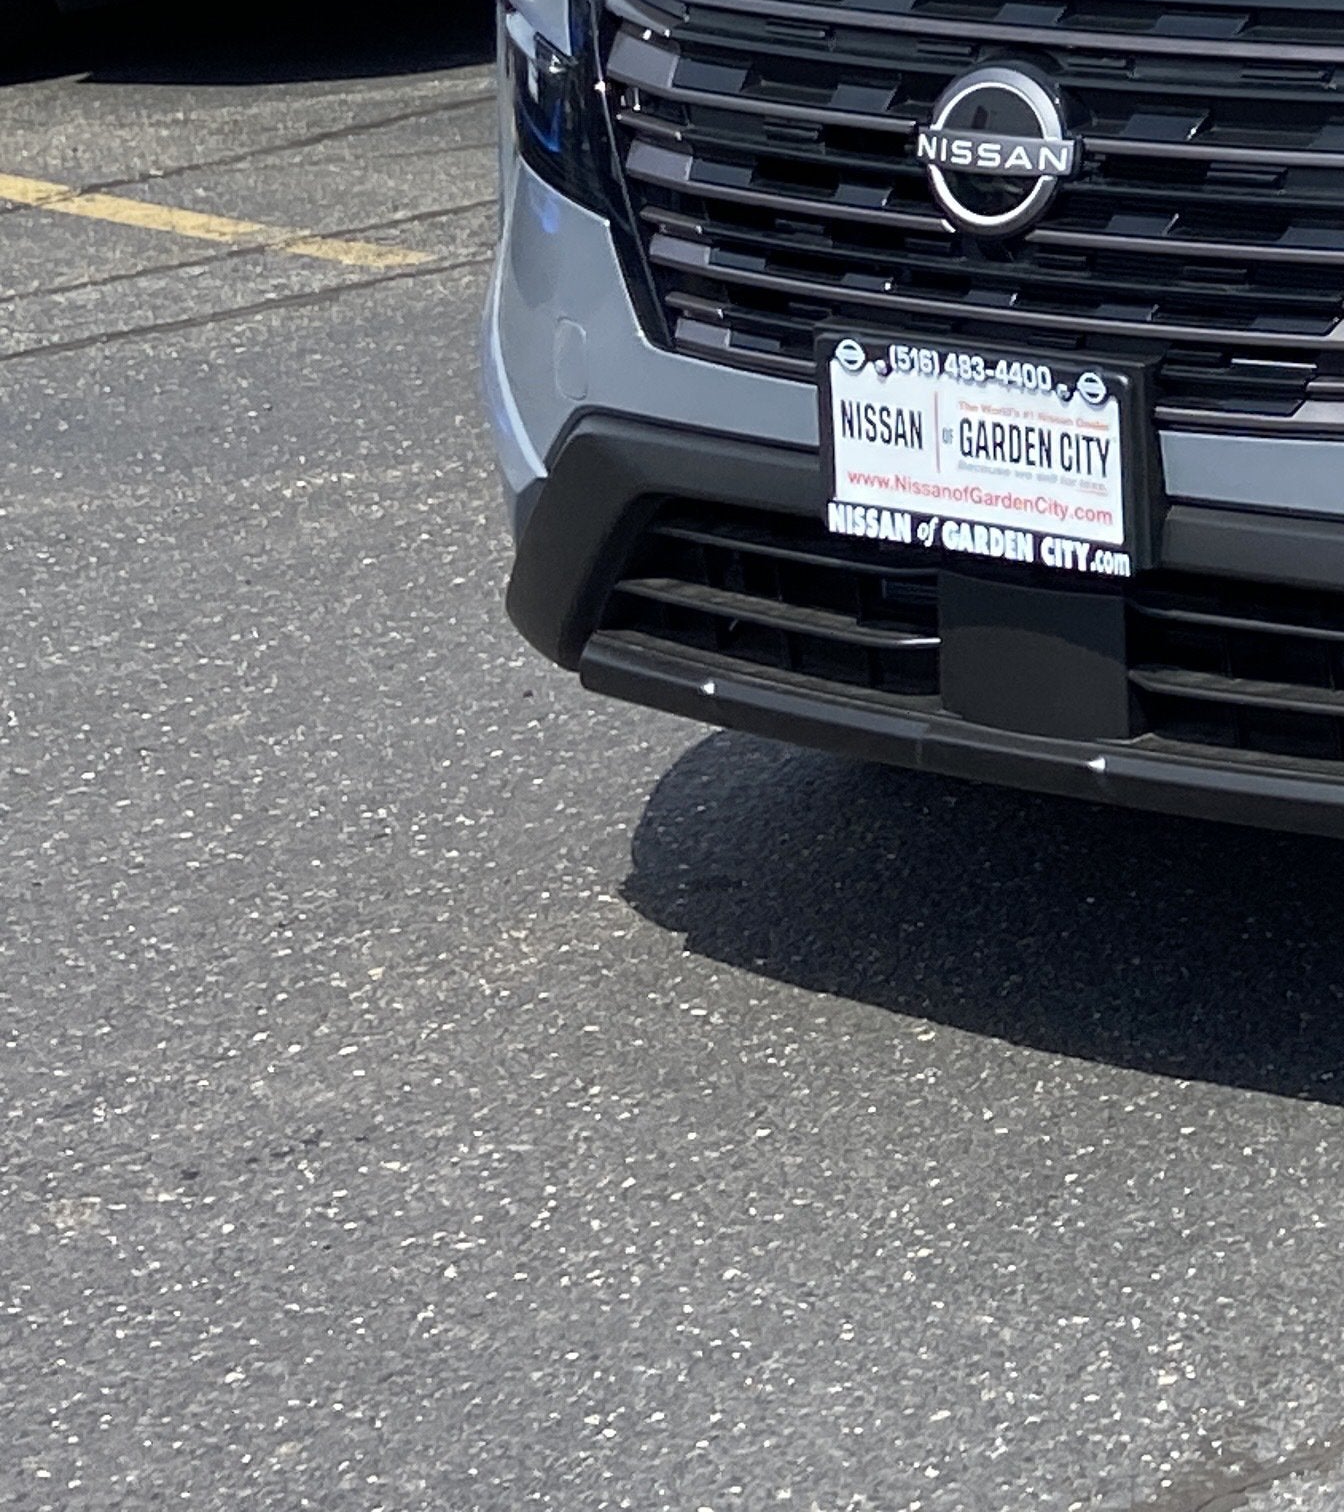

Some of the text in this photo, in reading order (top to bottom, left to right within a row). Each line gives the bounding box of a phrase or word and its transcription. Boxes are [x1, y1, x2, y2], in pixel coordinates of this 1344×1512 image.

[917, 133, 1068, 171] NISSAN
[889, 344, 1051, 390] (516) 483-4400
[841, 399, 923, 450] NISSAN
[959, 417, 1052, 469] GARDEN
[1060, 431, 1110, 478] CITY
[847, 471, 1113, 526] www.NissanofGardenCity.com
[827, 501, 1131, 577] NISSAN of GARDEN CITY.com
